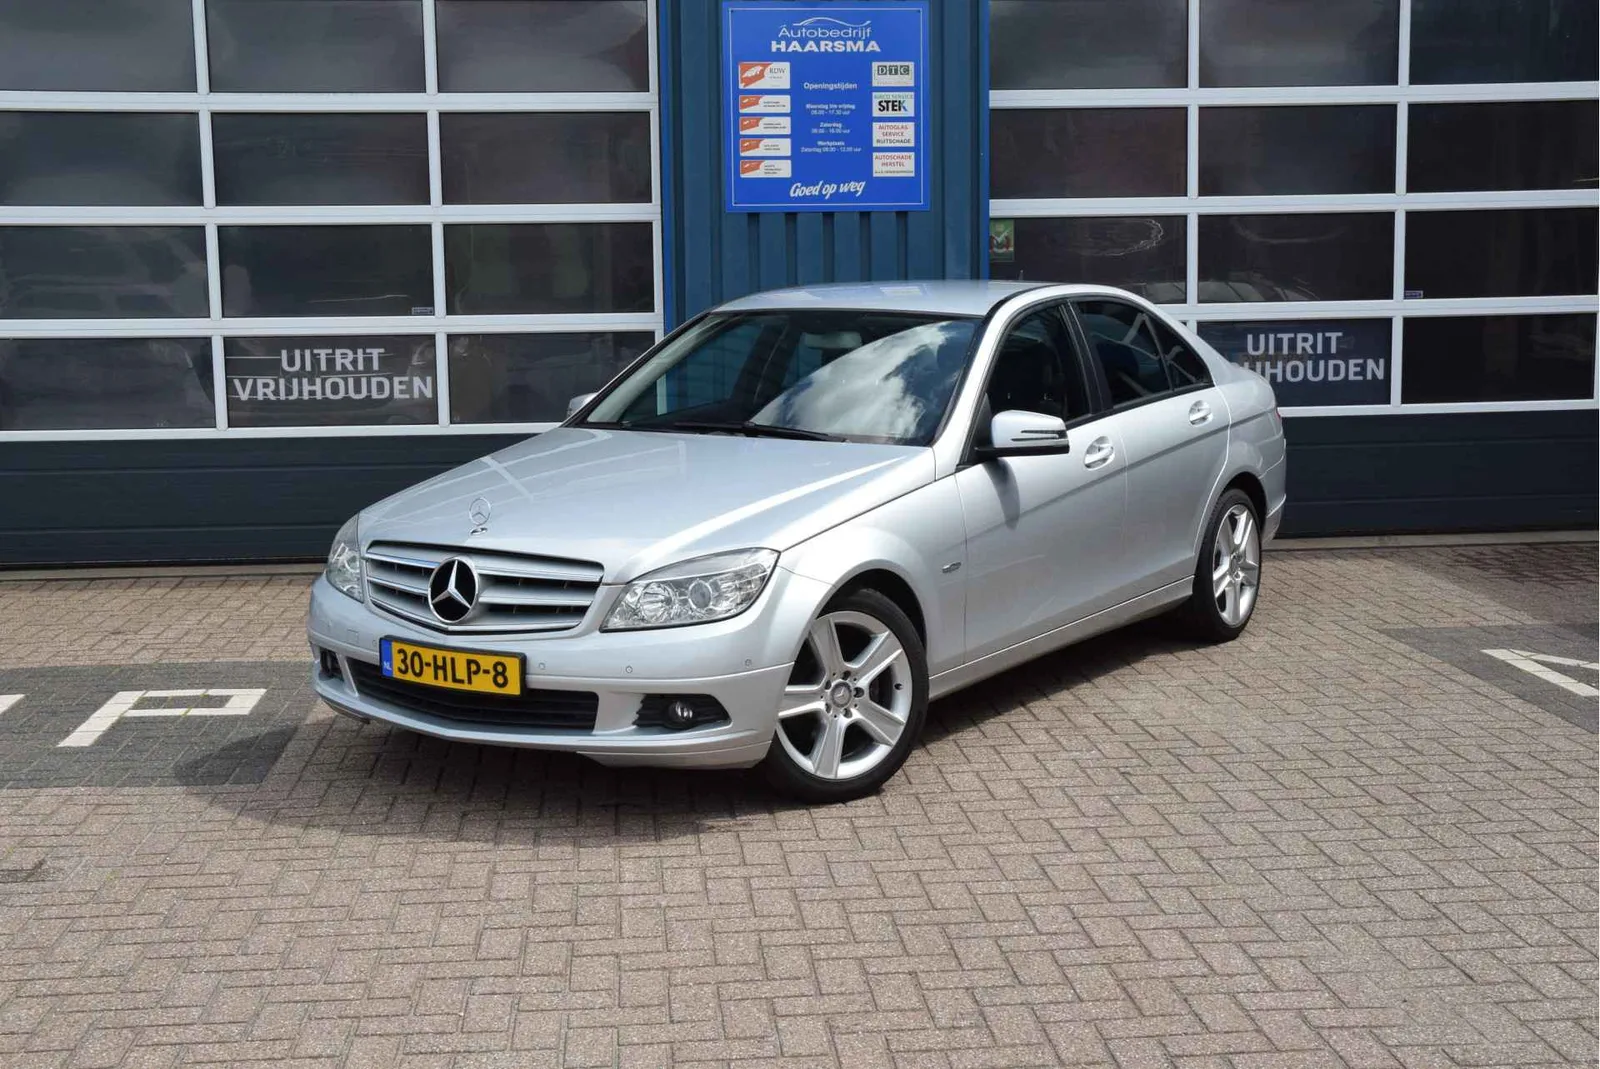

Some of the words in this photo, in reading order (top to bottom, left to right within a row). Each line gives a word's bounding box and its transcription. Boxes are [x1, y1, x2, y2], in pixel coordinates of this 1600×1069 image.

[778, 25, 872, 39] Autobedrijf
[771, 40, 881, 52] HAARSMA
[878, 65, 909, 75] DTC
[803, 82, 858, 91] Openingstijden
[878, 100, 908, 112] STEK
[789, 180, 823, 198] Goed
[821, 183, 837, 200] op
[839, 181, 866, 197] weg
[1247, 332, 1343, 356] UITRIT
[281, 348, 385, 372] UITRIT
[233, 376, 432, 401] VRIJHOUDEN
[383, 661, 392, 670] NL
[397, 648, 509, 689] 30-HLP-8
